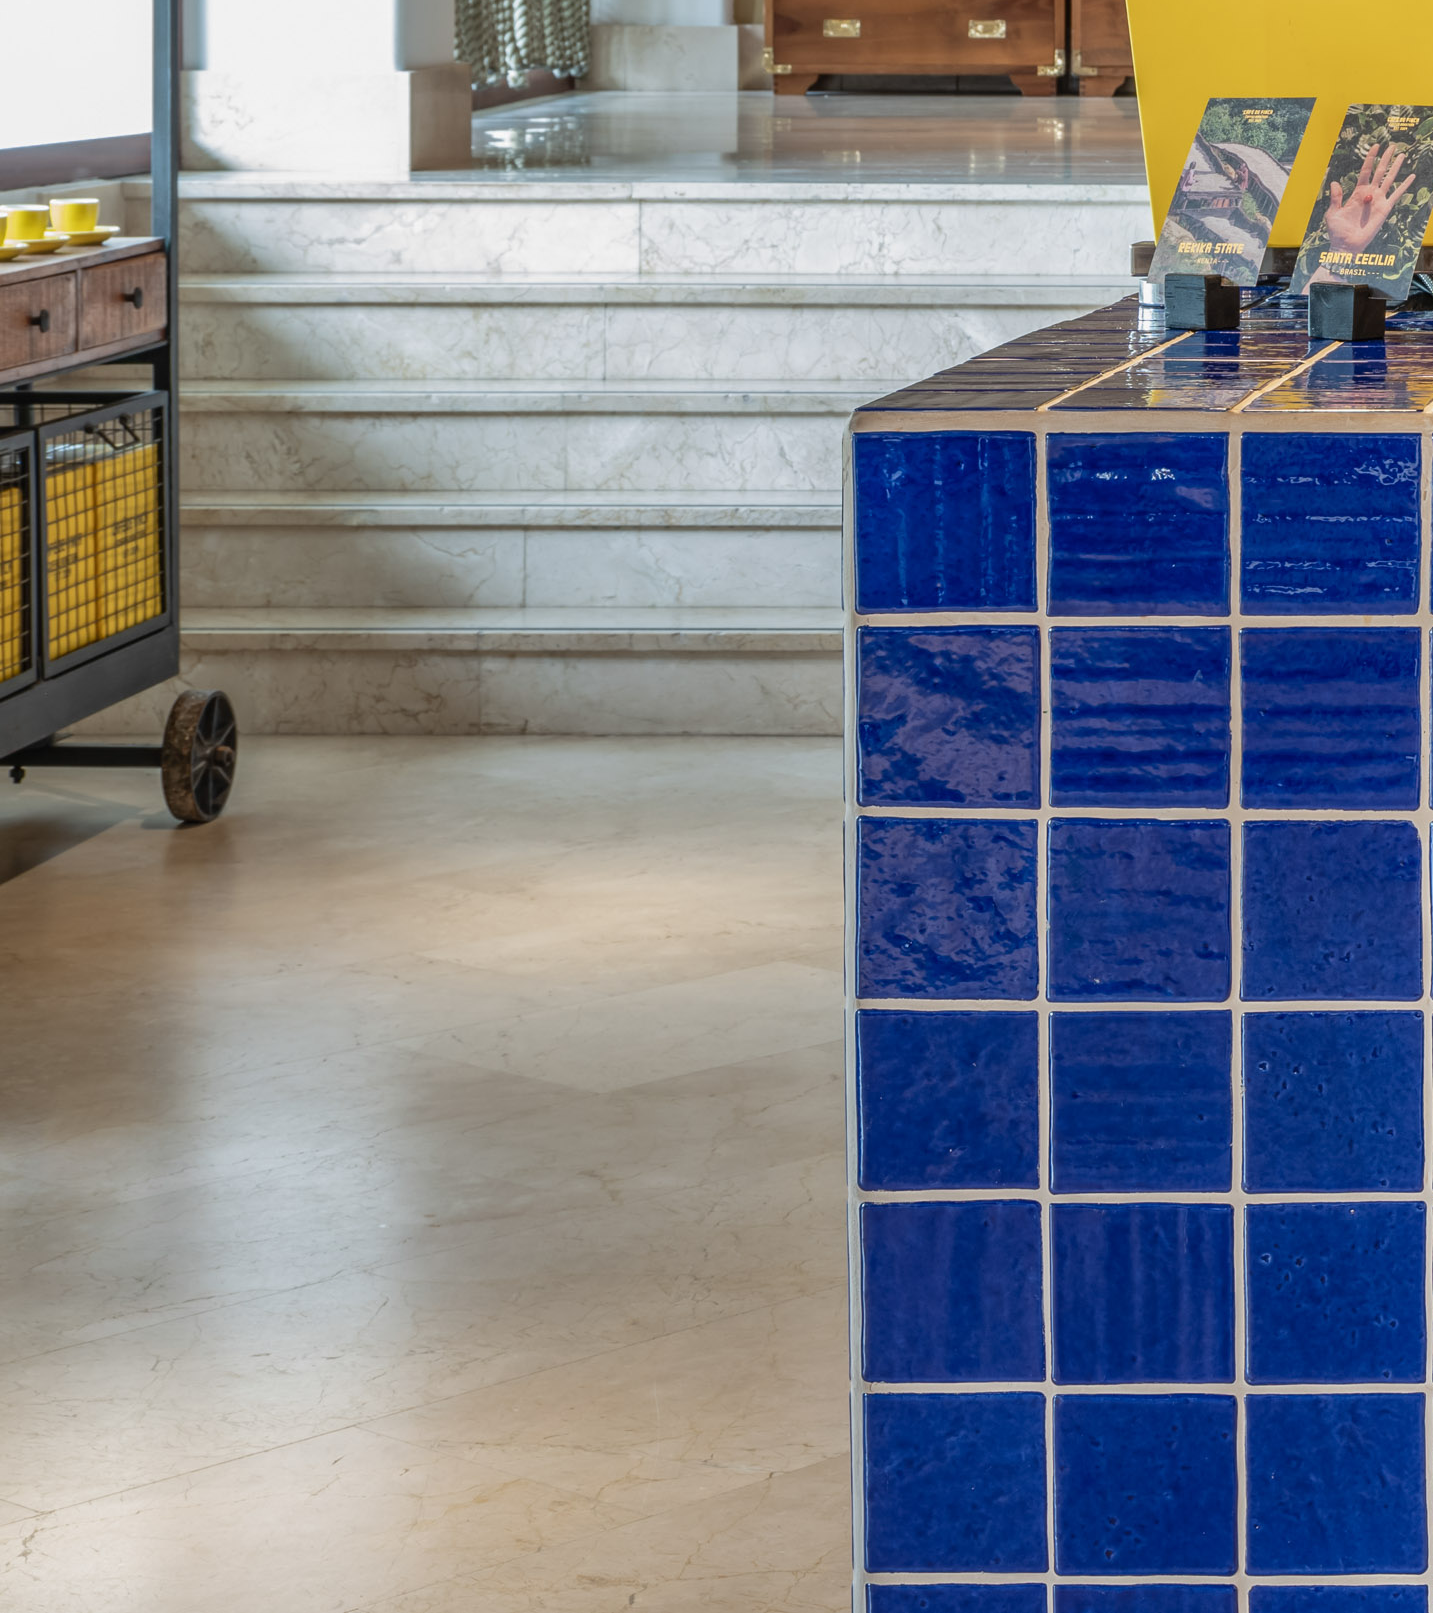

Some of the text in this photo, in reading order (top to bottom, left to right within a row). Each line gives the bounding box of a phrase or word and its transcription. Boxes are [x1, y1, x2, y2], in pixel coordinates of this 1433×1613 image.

[1214, 243, 1245, 255] STATE
[1319, 251, 1396, 266] SANTA CECILIA
